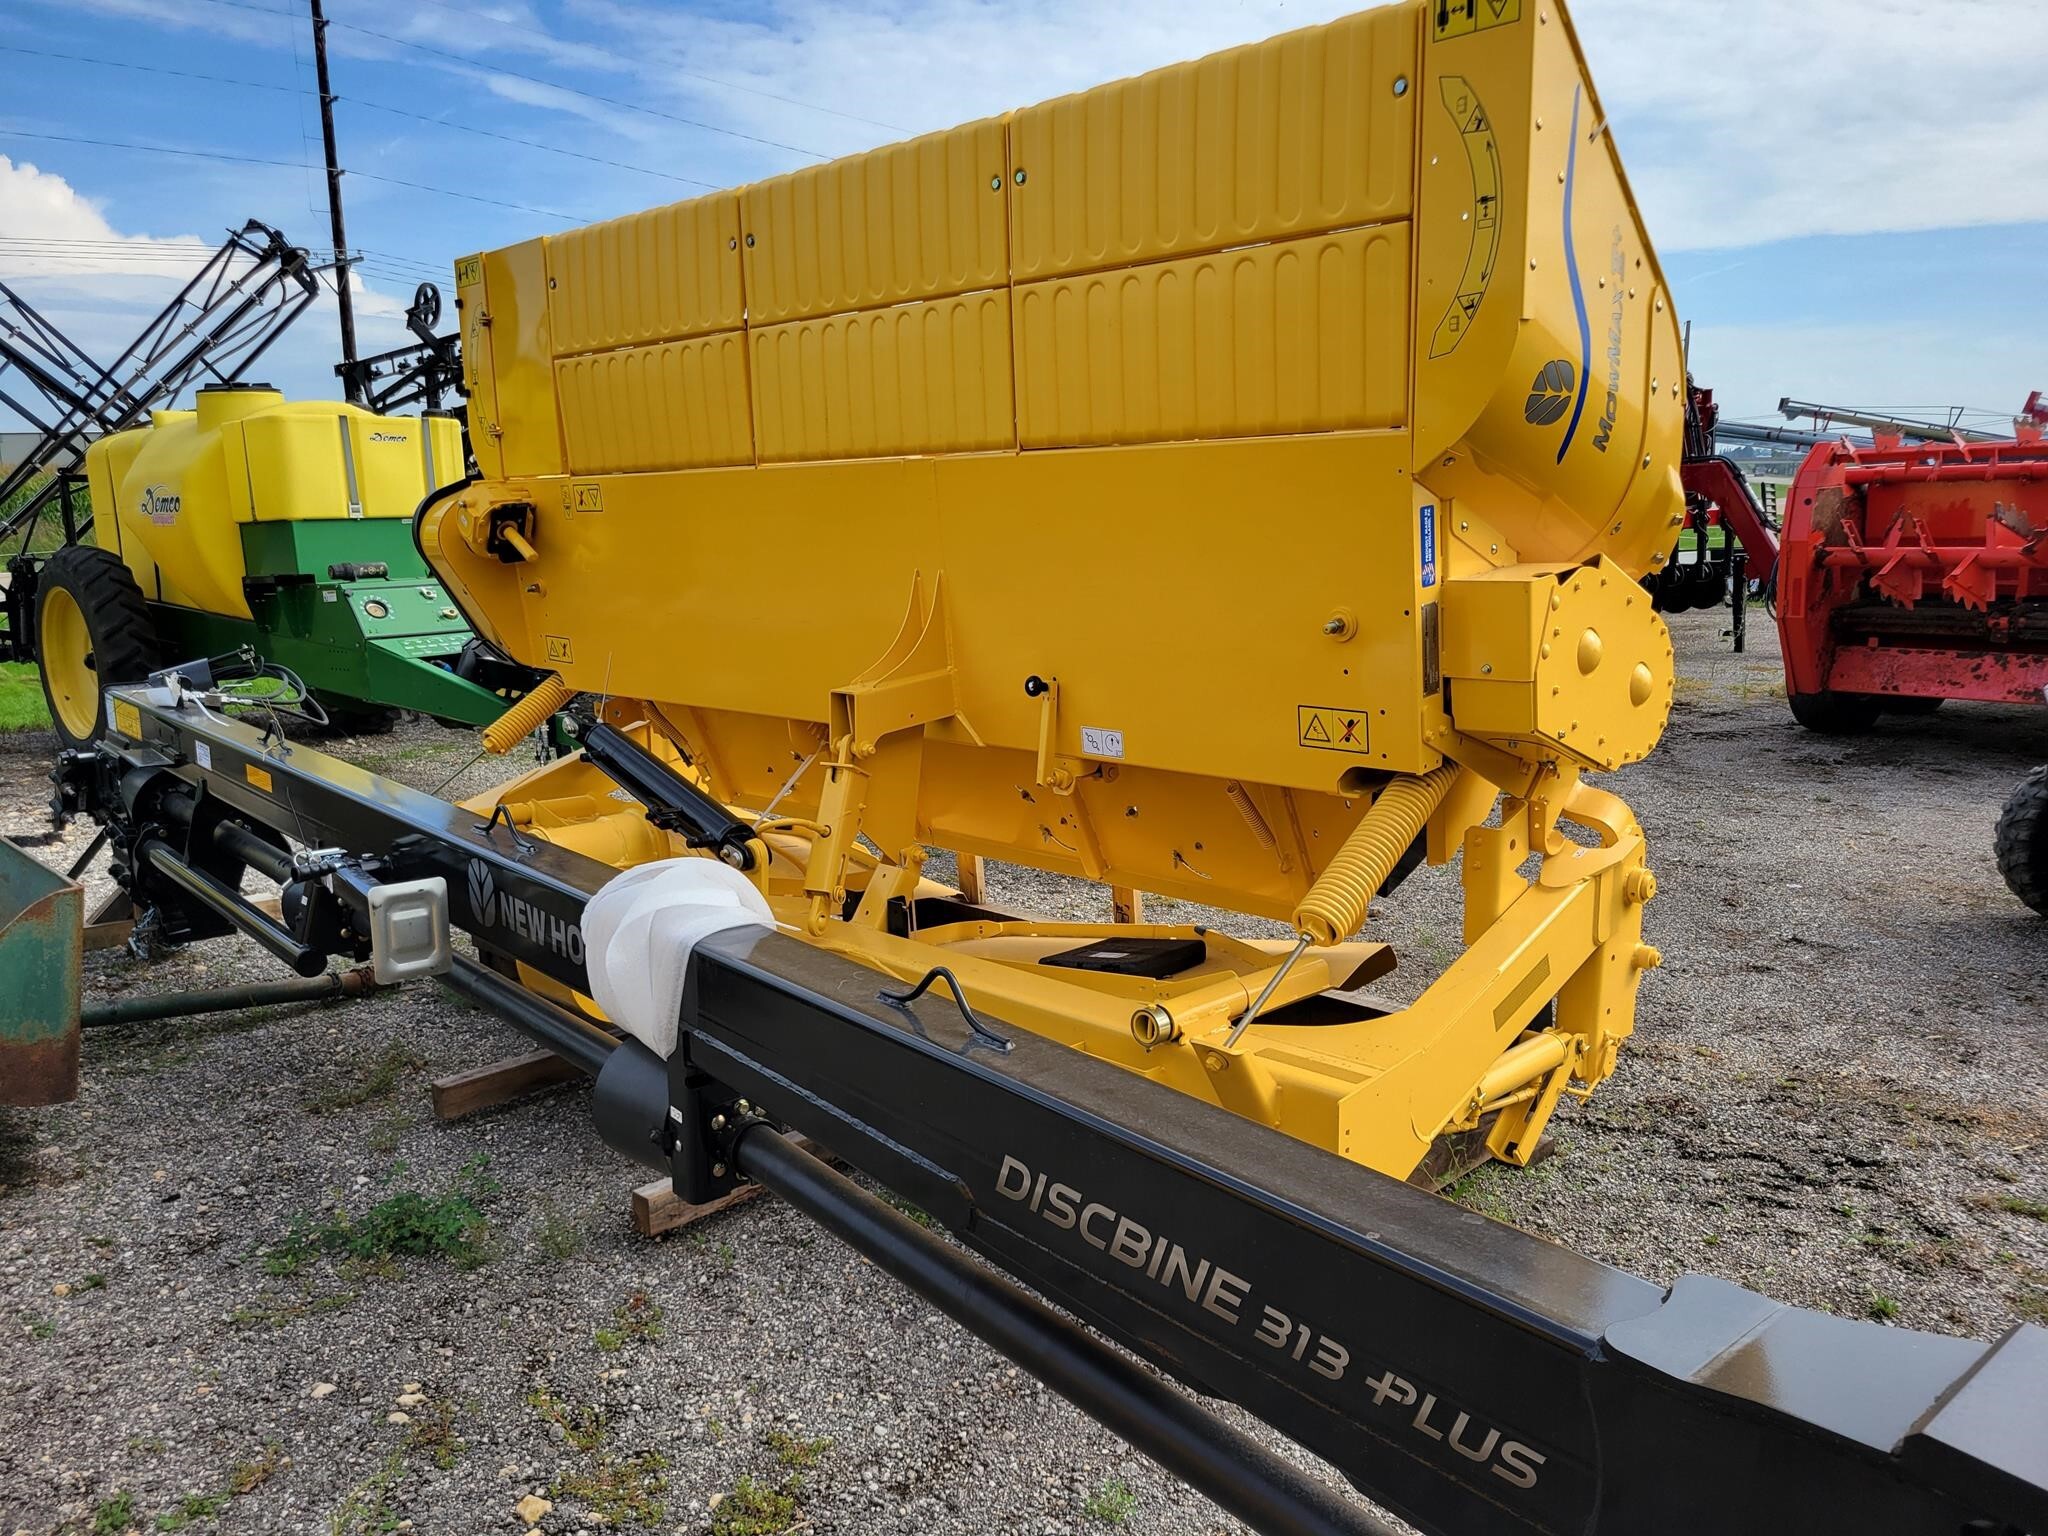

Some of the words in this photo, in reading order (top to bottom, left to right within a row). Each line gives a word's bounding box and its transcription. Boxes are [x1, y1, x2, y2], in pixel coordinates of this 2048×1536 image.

[499, 890, 546, 946] NEW
[994, 1153, 1252, 1326] DISCBINE
[1253, 1304, 1350, 1381] 313
